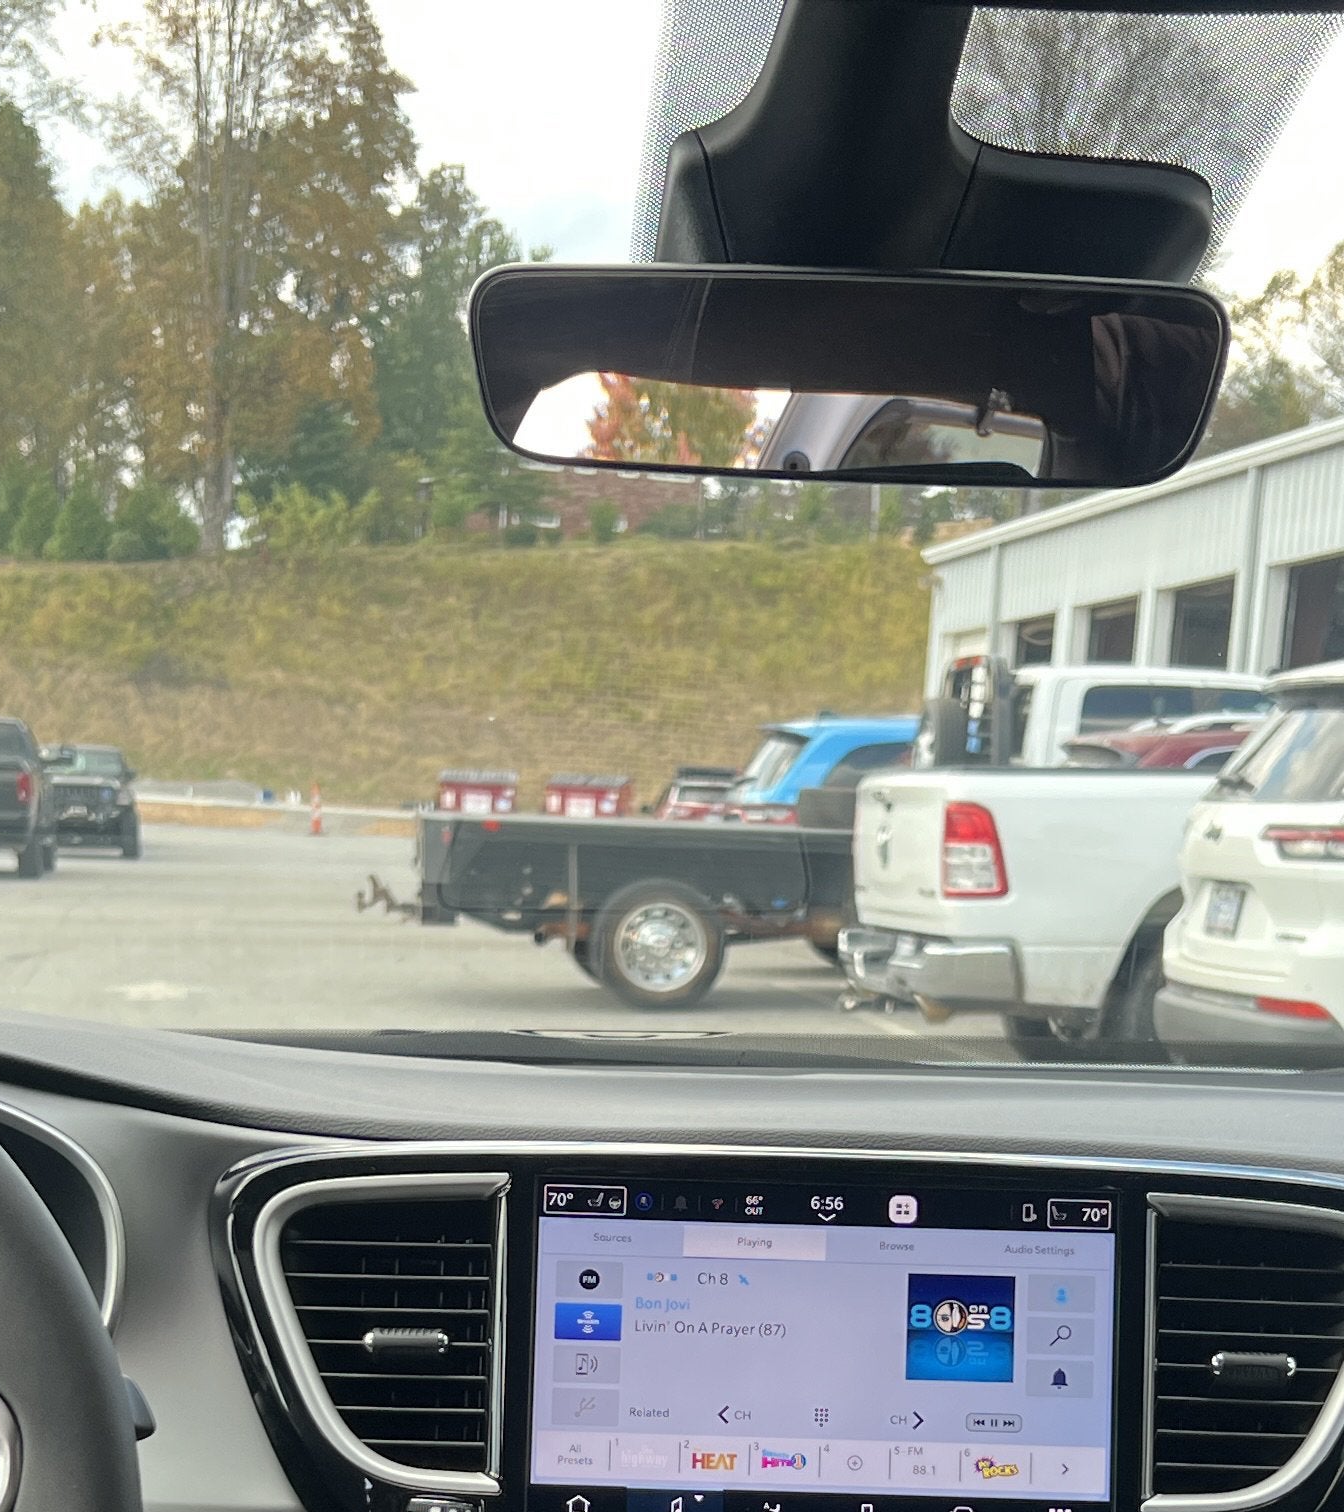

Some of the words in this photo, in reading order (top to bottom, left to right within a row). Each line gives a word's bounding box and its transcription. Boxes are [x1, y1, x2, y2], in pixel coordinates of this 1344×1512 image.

[810, 1196, 844, 1211] 6:56
[744, 1206, 764, 1216] OUT
[593, 1232, 632, 1243] Sources
[737, 1237, 773, 1248] Playing
[879, 1241, 915, 1251] Browse
[1005, 1244, 1033, 1255] Audio
[1034, 1245, 1075, 1257] Settings
[582, 1275, 597, 1284] FM
[697, 1272, 716, 1286] Ch
[719, 1273, 729, 1286] 8
[635, 1297, 662, 1310] Bon
[664, 1298, 690, 1313] Jovi
[634, 1319, 671, 1333] Livin'
[674, 1321, 695, 1334] On
[697, 1322, 709, 1334] A
[711, 1322, 756, 1338] Prayer
[758, 1322, 787, 1339] (87)
[629, 1407, 670, 1418] Related
[734, 1410, 752, 1421] CH
[890, 1414, 907, 1425] CH
[569, 1443, 582, 1453] All
[683, 1440, 690, 1449] 2
[753, 1442, 760, 1451] 3
[823, 1444, 831, 1453] 4
[907, 1447, 923, 1455] FM
[964, 1448, 971, 1457] 6
[557, 1454, 594, 1465] Presets
[691, 1452, 738, 1471] HEAT
[912, 1465, 936, 1475] 88.1
